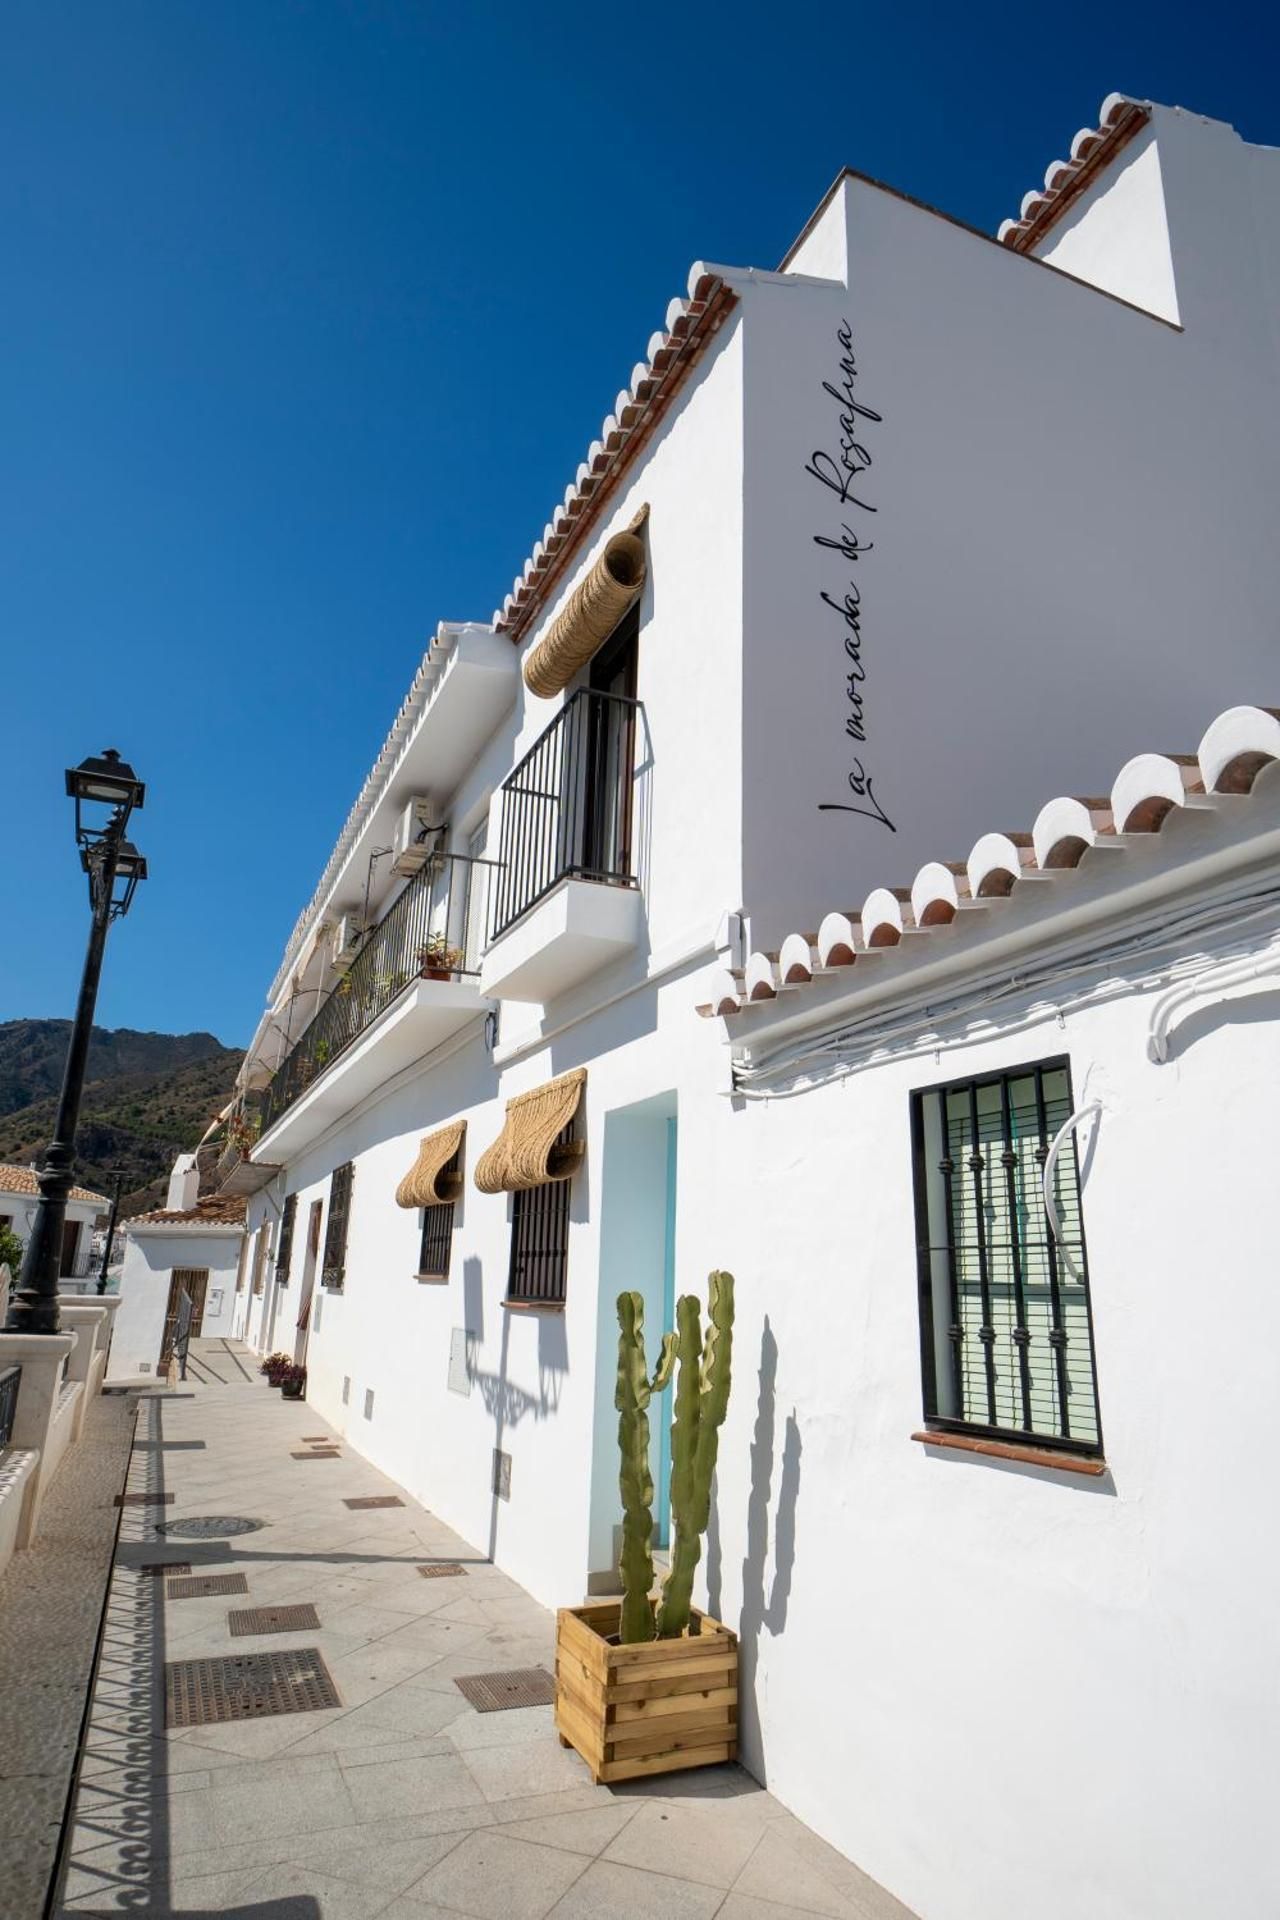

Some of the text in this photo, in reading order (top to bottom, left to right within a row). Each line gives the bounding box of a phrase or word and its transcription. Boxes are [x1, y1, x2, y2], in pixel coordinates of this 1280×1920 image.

[805, 319, 897, 833] La morada de Rosafina
